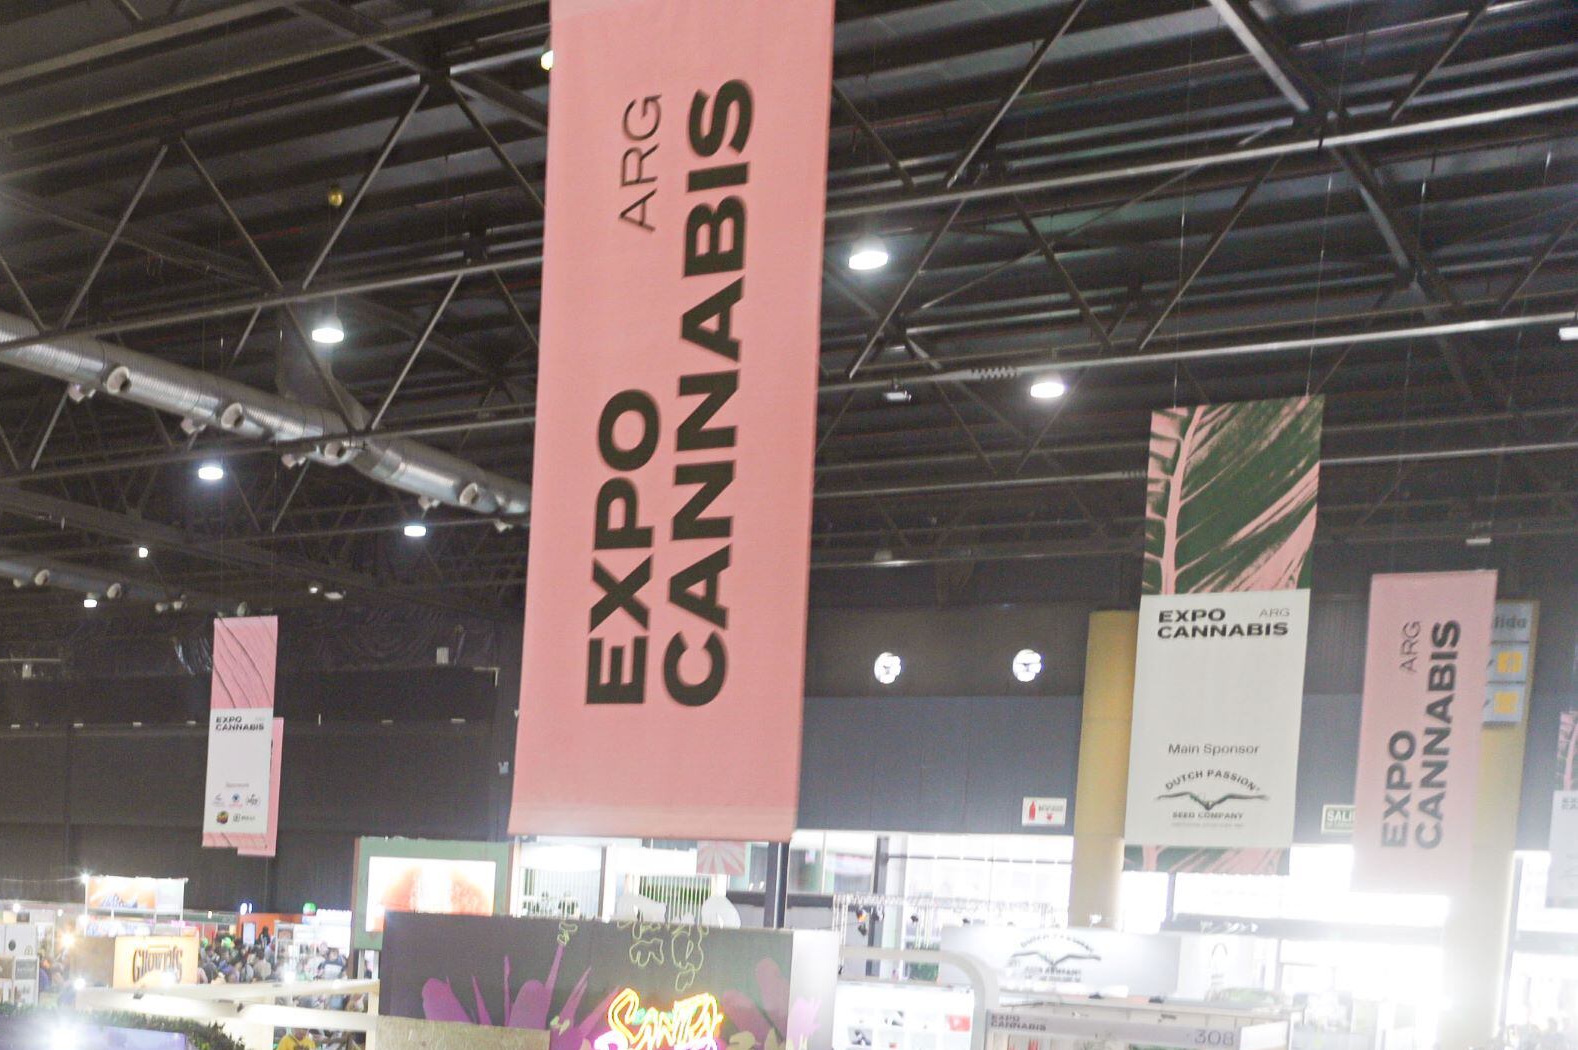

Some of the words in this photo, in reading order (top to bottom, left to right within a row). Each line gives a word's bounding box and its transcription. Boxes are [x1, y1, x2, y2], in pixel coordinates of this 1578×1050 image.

[618, 93, 663, 233] ARG
[662, 78, 755, 709] CANNABIS
[585, 388, 662, 707] EXPO
[1158, 608, 1226, 624] EXPO
[1258, 607, 1291, 618] ARG
[1494, 615, 1528, 629] lida
[1157, 622, 1289, 640] CANNABIS
[215, 715, 242, 724] EXPO
[215, 723, 265, 732] CANNABIS
[1381, 729, 1417, 848] EXPO
[1399, 620, 1422, 673] ARG
[1415, 618, 1462, 850] CANNABIS
[1168, 743, 1199, 754] Main
[1204, 743, 1259, 756] Sponsor
[1165, 770, 1203, 791] DUTCH
[1207, 769, 1257, 791] PASSION
[1172, 811, 1196, 819] SEED
[1198, 811, 1245, 819] COMPANY
[1326, 809, 1356, 821] SALI
[1194, 1029, 1234, 1047] 308
